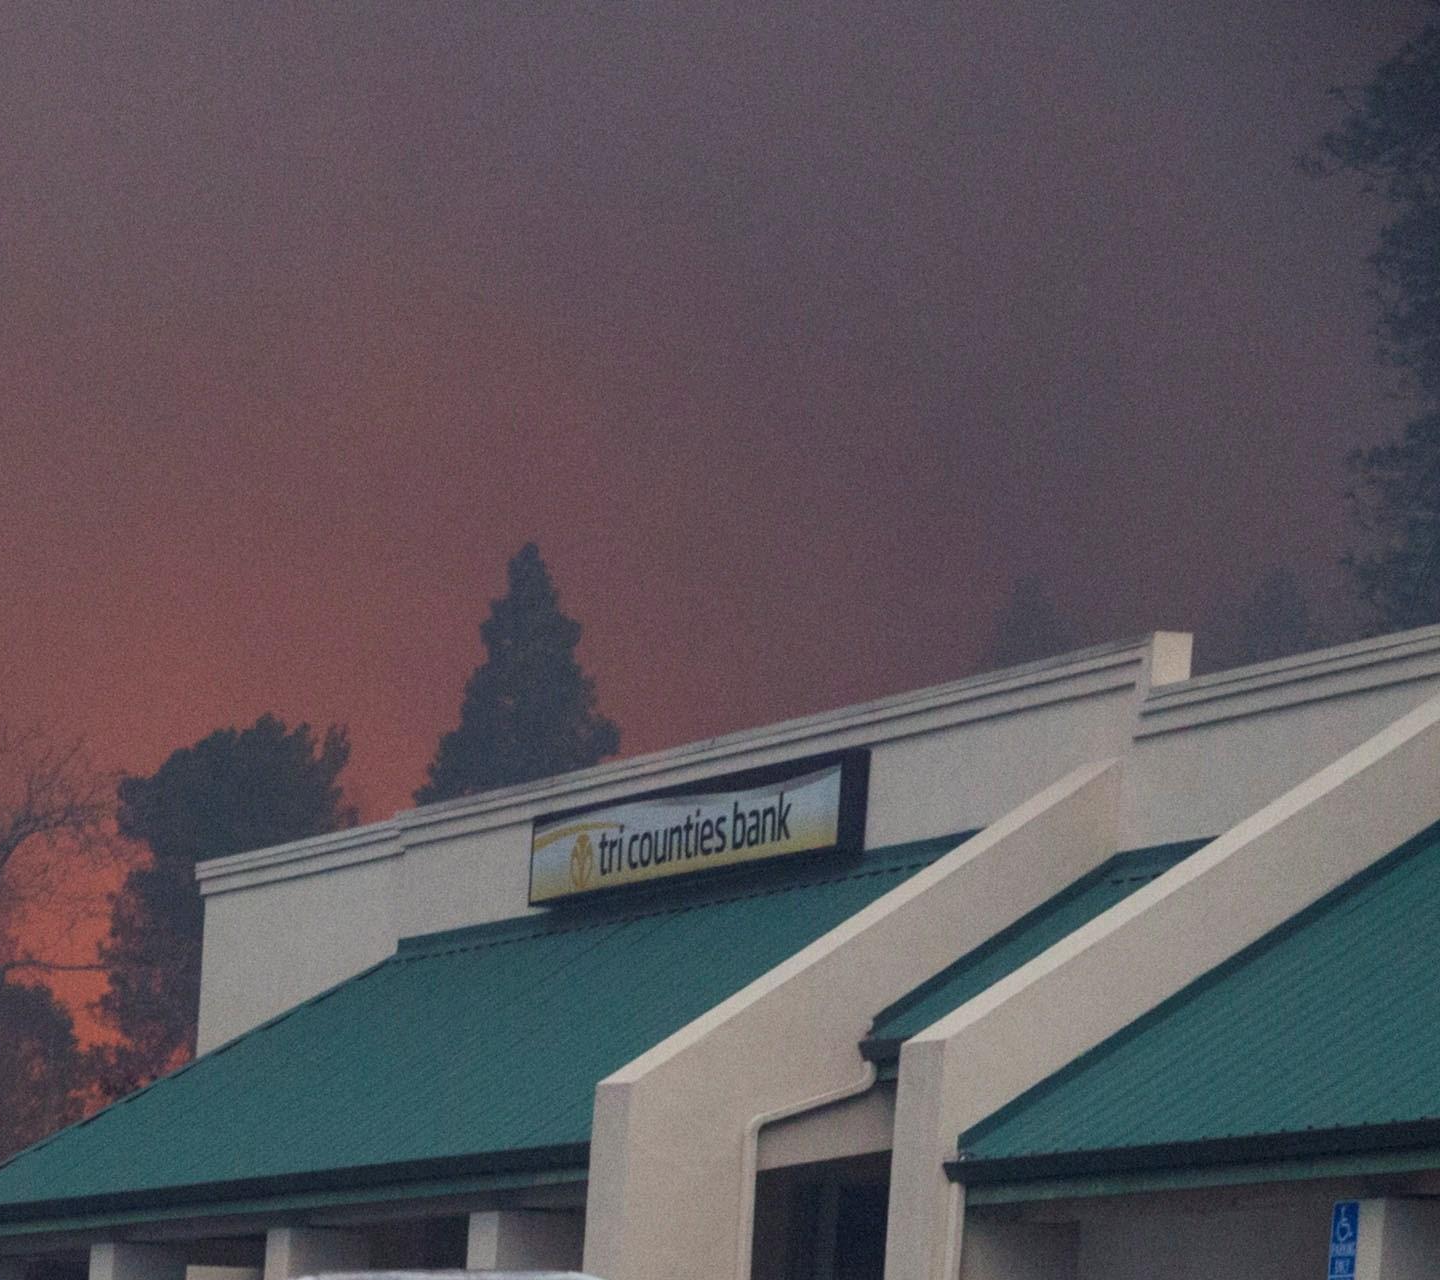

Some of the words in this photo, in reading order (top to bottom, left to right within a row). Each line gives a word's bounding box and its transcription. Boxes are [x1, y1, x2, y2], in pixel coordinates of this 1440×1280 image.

[599, 824, 624, 875] tri
[628, 808, 727, 869] counties
[732, 791, 792, 850] bank
